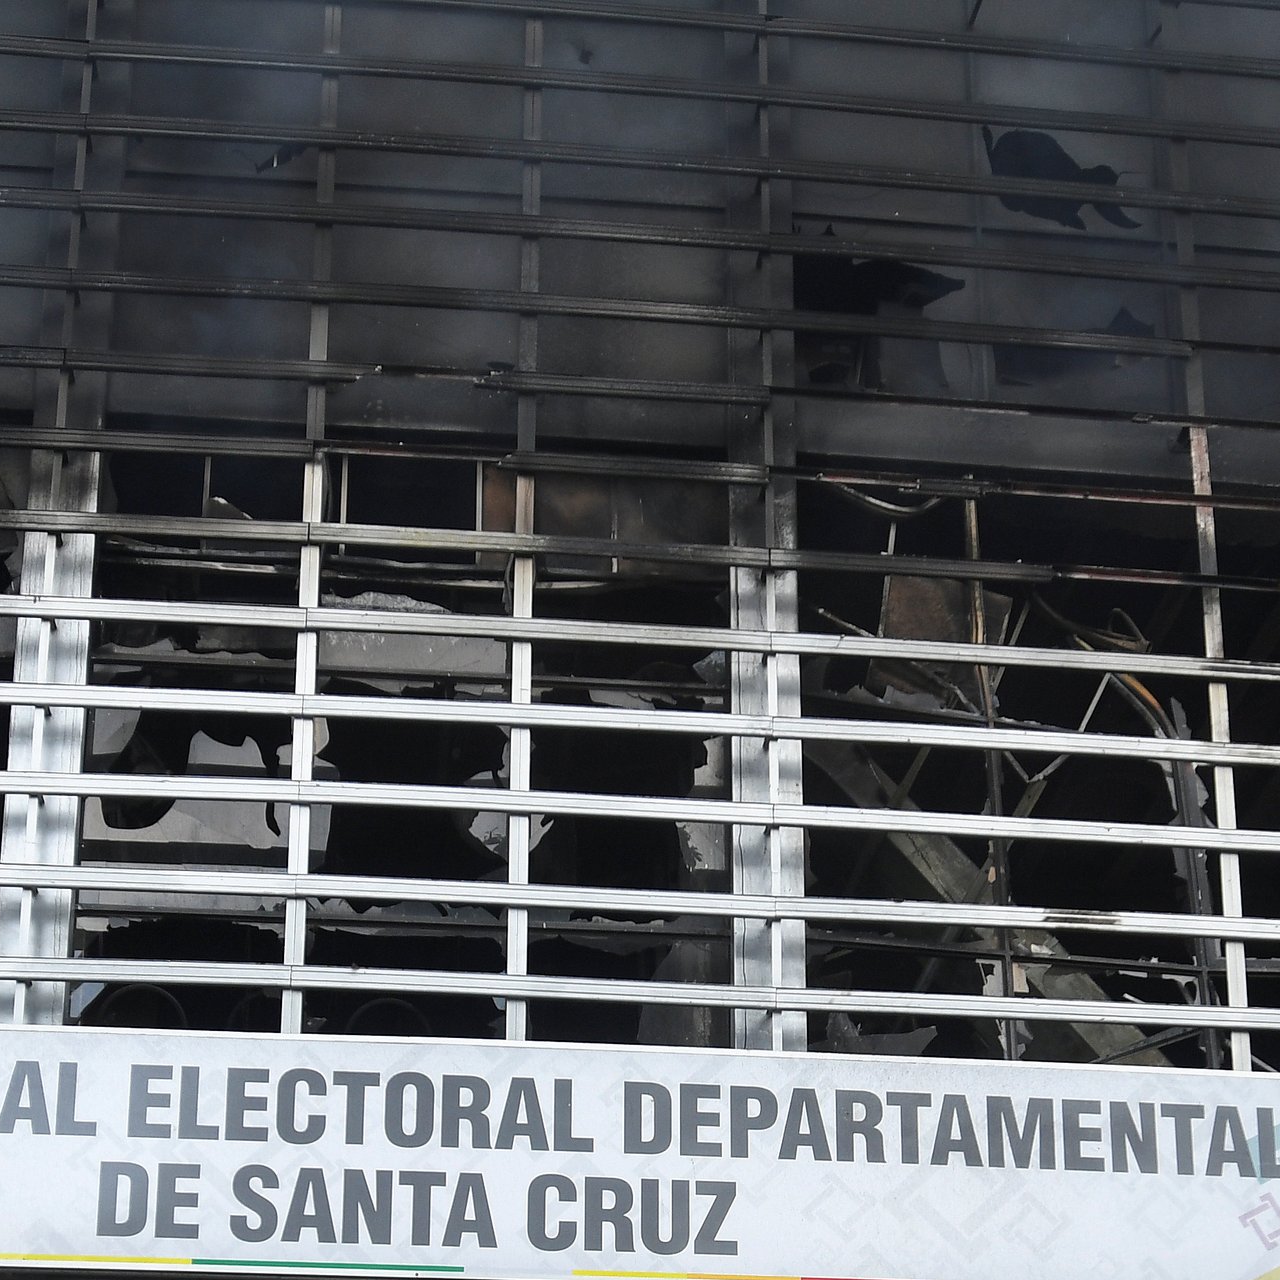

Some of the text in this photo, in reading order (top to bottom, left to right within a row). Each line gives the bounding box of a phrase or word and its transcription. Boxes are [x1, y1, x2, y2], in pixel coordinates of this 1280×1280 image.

[127, 1064, 594, 1153] ELECTORAL
[96, 1161, 739, 1256] DE SANTA CRUZ
